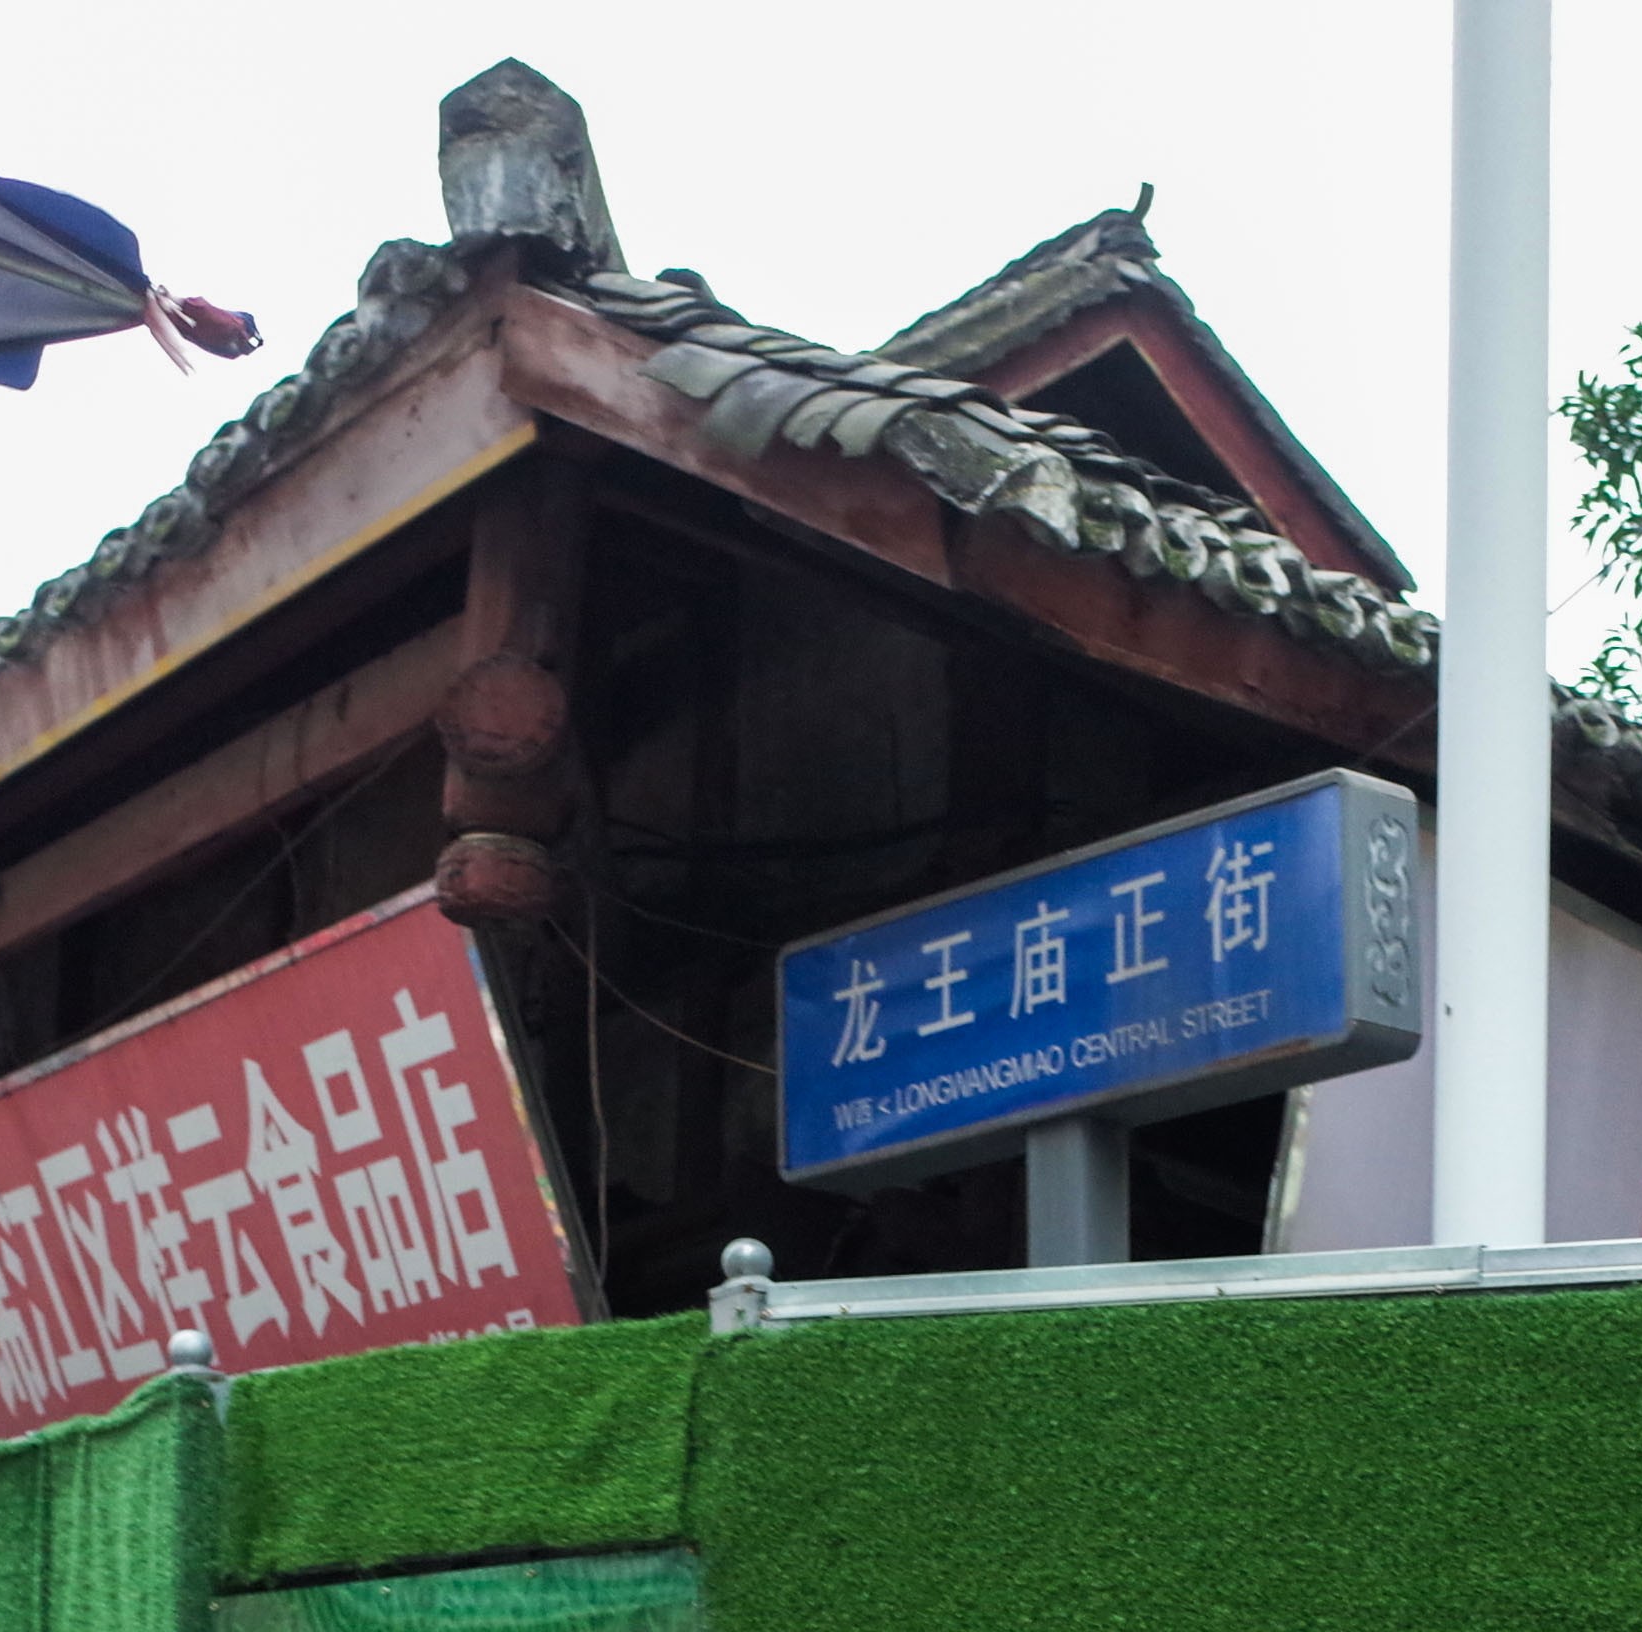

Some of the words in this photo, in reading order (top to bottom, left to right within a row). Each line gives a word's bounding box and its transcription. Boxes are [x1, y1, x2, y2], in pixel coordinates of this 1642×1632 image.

[832, 840, 1275, 1068] 龙王庙正街
[897, 1045, 1065, 1115] LONGWANGMIAO
[1071, 1022, 1173, 1067] CENTRAL
[1181, 990, 1272, 1040] STREET
